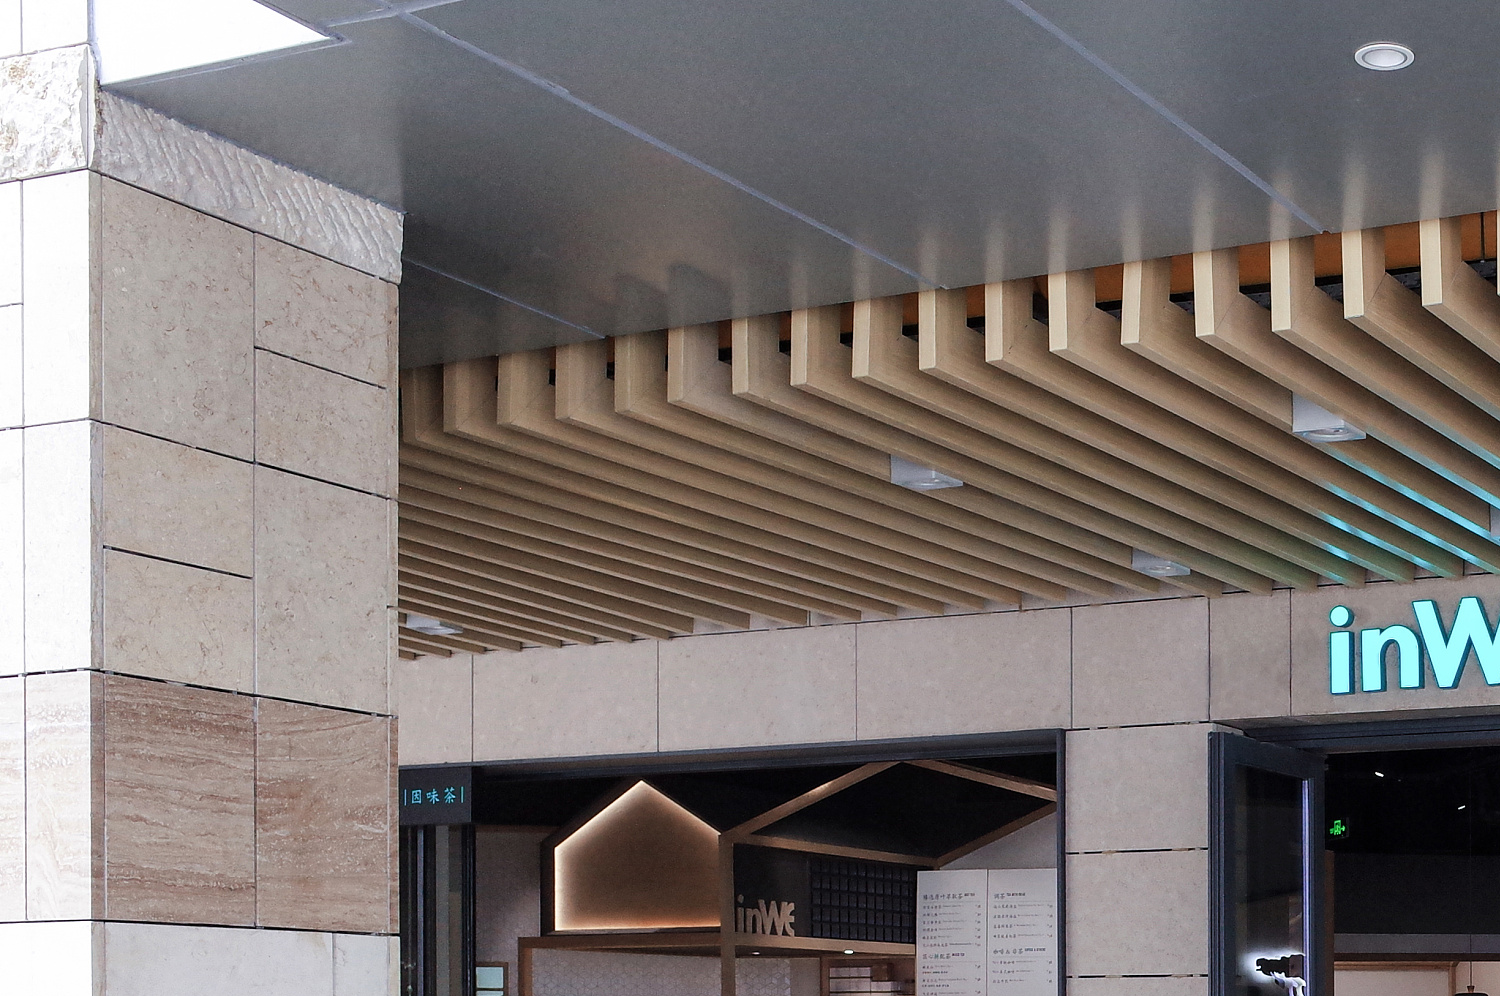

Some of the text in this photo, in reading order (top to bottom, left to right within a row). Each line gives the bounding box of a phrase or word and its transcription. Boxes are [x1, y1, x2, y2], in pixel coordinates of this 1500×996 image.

[411, 786, 457, 805] 因味茶
[737, 894, 795, 937] inWE
